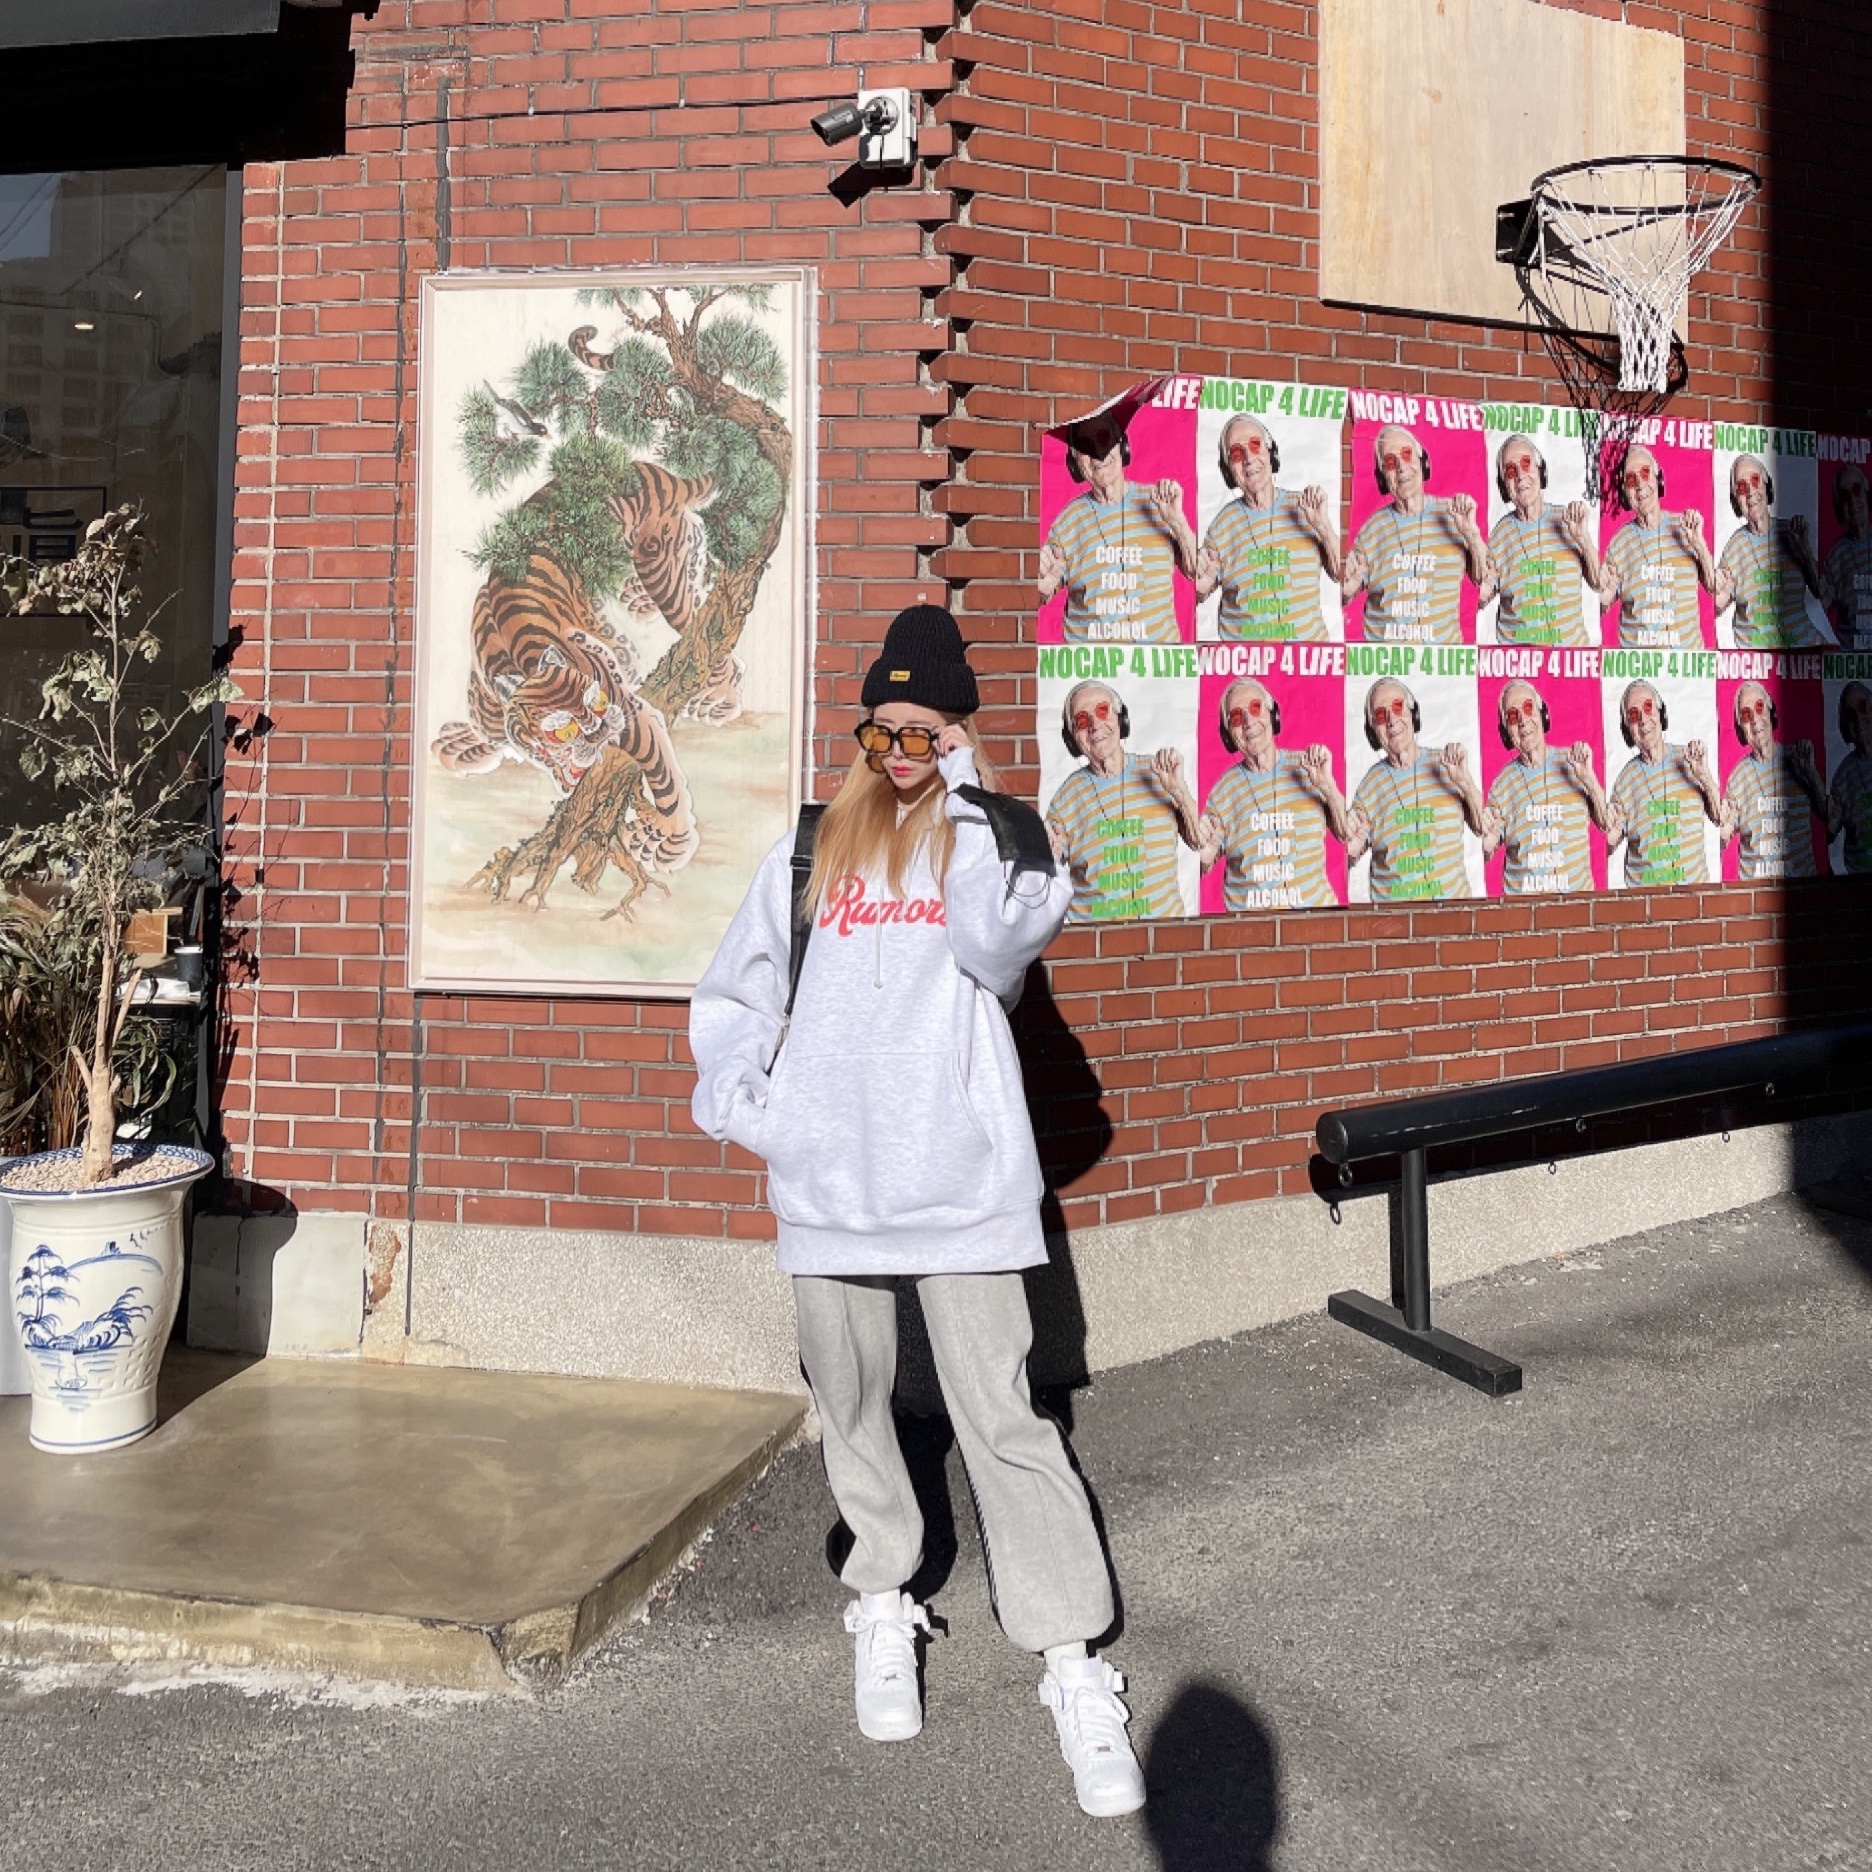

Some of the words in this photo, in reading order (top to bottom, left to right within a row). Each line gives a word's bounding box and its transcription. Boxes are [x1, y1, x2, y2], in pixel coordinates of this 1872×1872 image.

[1200, 380, 1273, 413] NOCAP
[1278, 386, 1294, 415] 4
[1299, 387, 1347, 419] LIFE
[1351, 390, 1419, 425] NOCAP
[1425, 399, 1438, 427] 4
[1440, 400, 1483, 430] LIFE
[1482, 404, 1544, 433] NOCAP
[1547, 409, 1560, 435] 4
[1664, 420, 1676, 447] 4
[1680, 421, 1712, 449] LIFE
[1715, 425, 1768, 453] NOCAP
[1772, 430, 1781, 455] 4
[1786, 432, 1816, 457] LIFE
[1818, 434, 1870, 463] NOCAP
[1096, 546, 1142, 565] COFFEE
[1102, 572, 1136, 590] FOOD
[1398, 576, 1426, 593] FOOD
[1096, 597, 1140, 615] MUSIC
[1392, 600, 1428, 617] MUSIC
[1088, 622, 1148, 640] ALCOHOL
[1384, 623, 1434, 641] ALCOHOL
[1040, 646, 1124, 678] NOCAP
[1130, 647, 1146, 677] 4
[1152, 648, 1196, 678] LIFE
[1199, 646, 1274, 676] NOCAP
[1280, 646, 1294, 676] 4
[1300, 646, 1344, 676] LIFE
[1346, 646, 1415, 676] NOCAP
[1420, 647, 1433, 675] 4
[1437, 647, 1476, 676] LIFE
[1479, 648, 1544, 678] NOCAP
[1547, 648, 1560, 678] 4
[1565, 648, 1599, 678] LIFE
[1603, 650, 1664, 678] NOCAP
[1667, 652, 1679, 678] 4
[1682, 651, 1716, 678] LIFE
[1717, 652, 1772, 679] NOCAP
[1776, 653, 1786, 679] 4
[1789, 653, 1821, 679] LIFE
[1252, 812, 1294, 831] COFFEE
[1532, 828, 1558, 845] FOOD
[1258, 838, 1290, 857] FOOD
[1097, 871, 1144, 891] MUSIC
[1254, 863, 1294, 881] MUSIC
[1247, 887, 1304, 907] ALCOHOL
